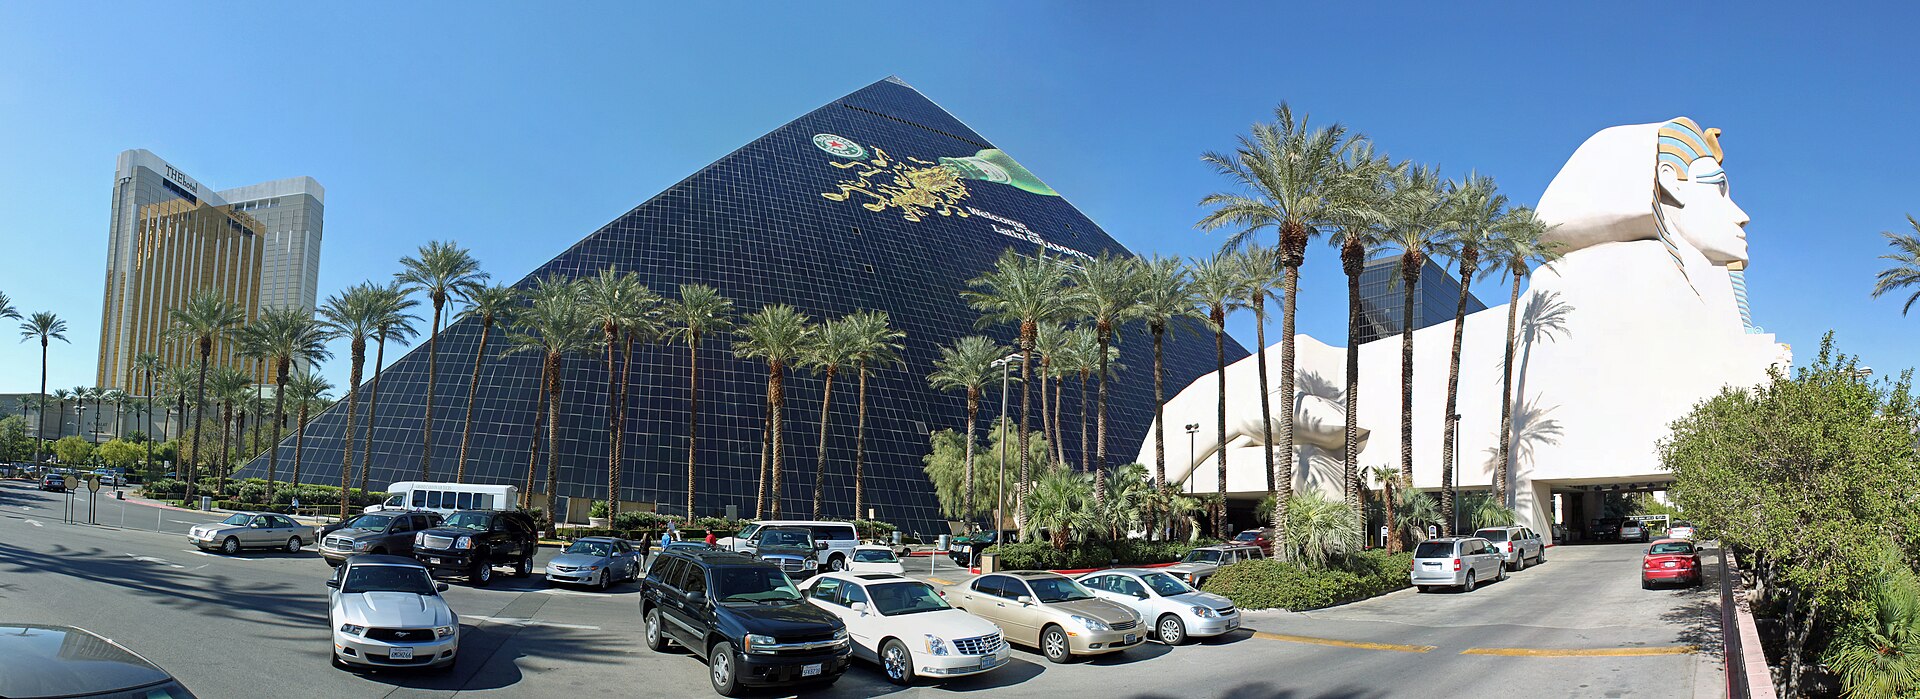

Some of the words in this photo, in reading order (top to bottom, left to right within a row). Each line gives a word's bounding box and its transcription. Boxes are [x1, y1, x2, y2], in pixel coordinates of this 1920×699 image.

[165, 164, 198, 193] THEhotel
[966, 206, 1027, 229] Welcome
[991, 223, 1027, 240] Latin
